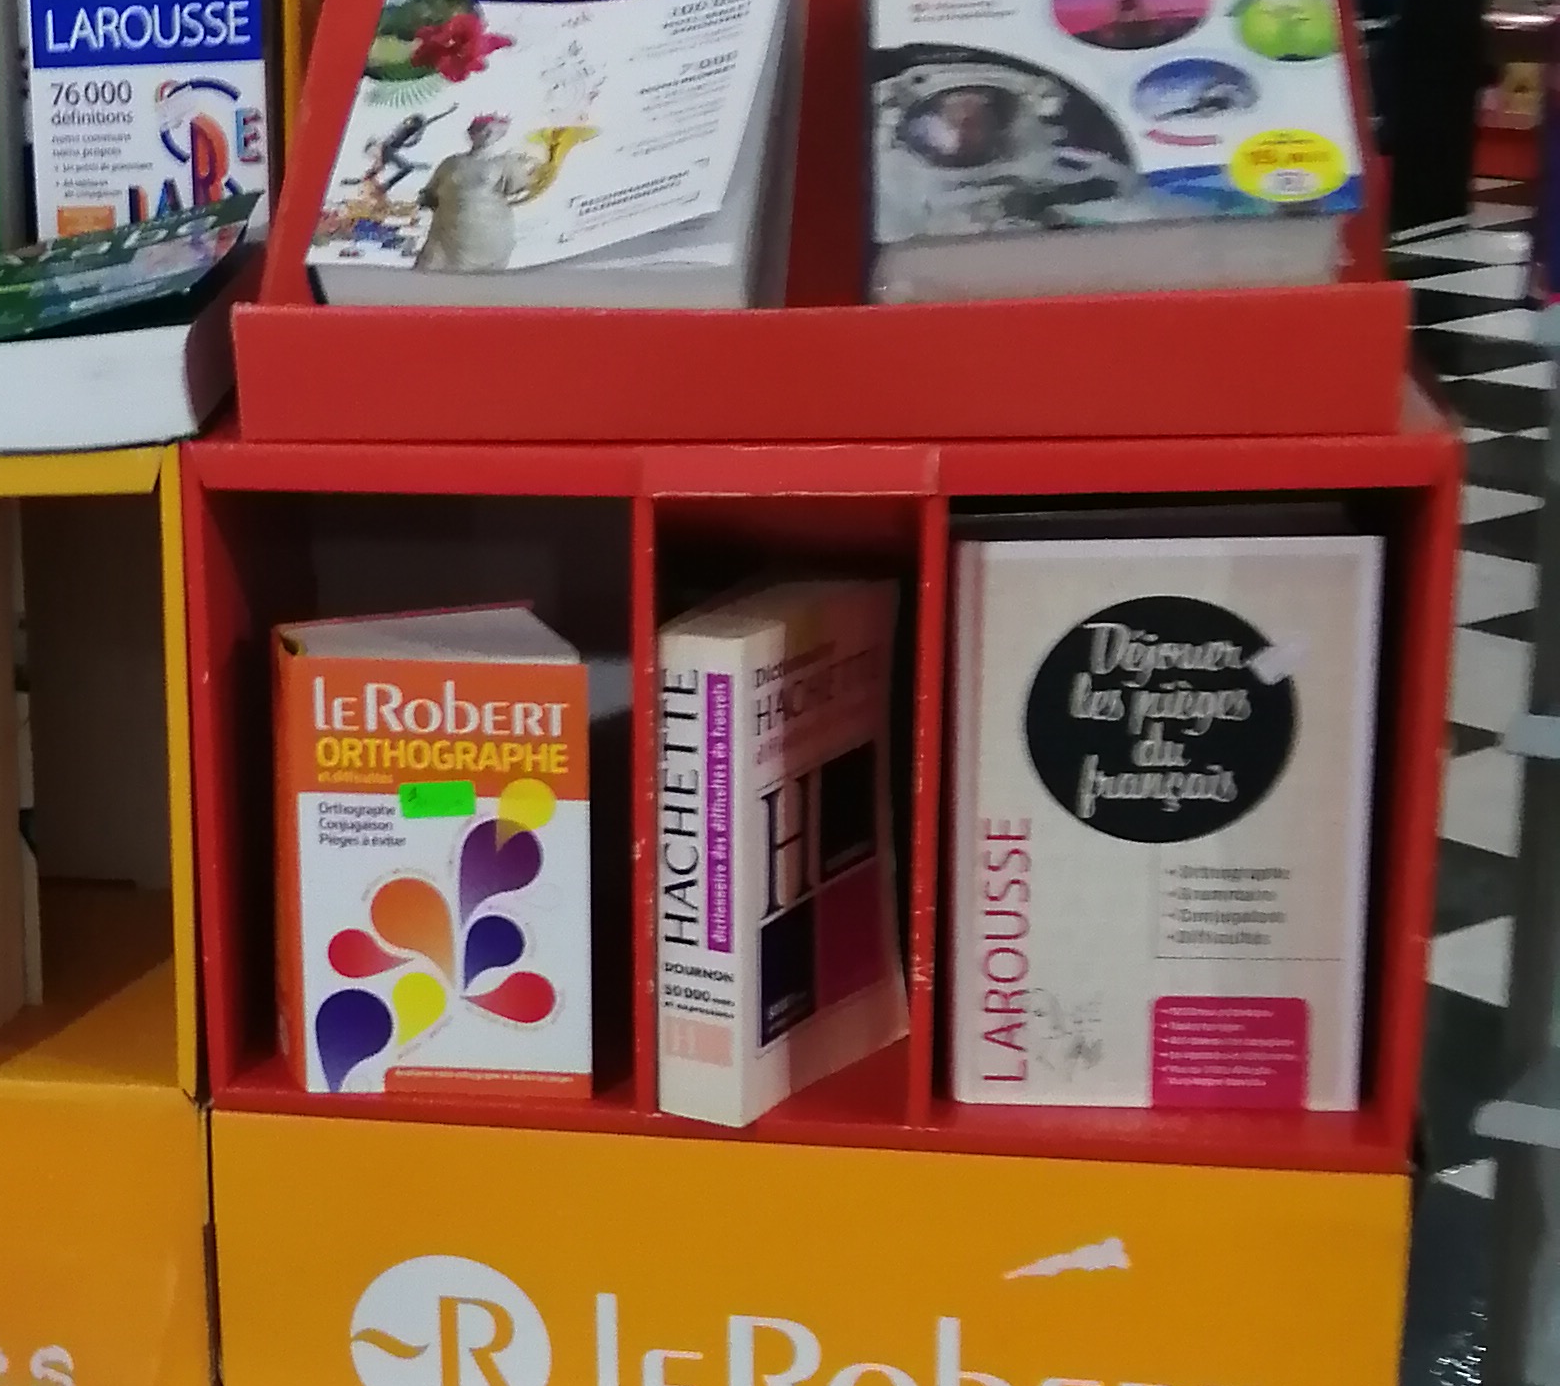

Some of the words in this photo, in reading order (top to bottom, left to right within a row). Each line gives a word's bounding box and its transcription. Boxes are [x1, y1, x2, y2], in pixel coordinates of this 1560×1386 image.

[44, 0, 252, 54] LAROUSSE
[315, 736, 570, 775] ORTHOGRAPHE
[663, 666, 701, 948] HACHETTE
[980, 817, 1034, 1084] LAROUSSE
